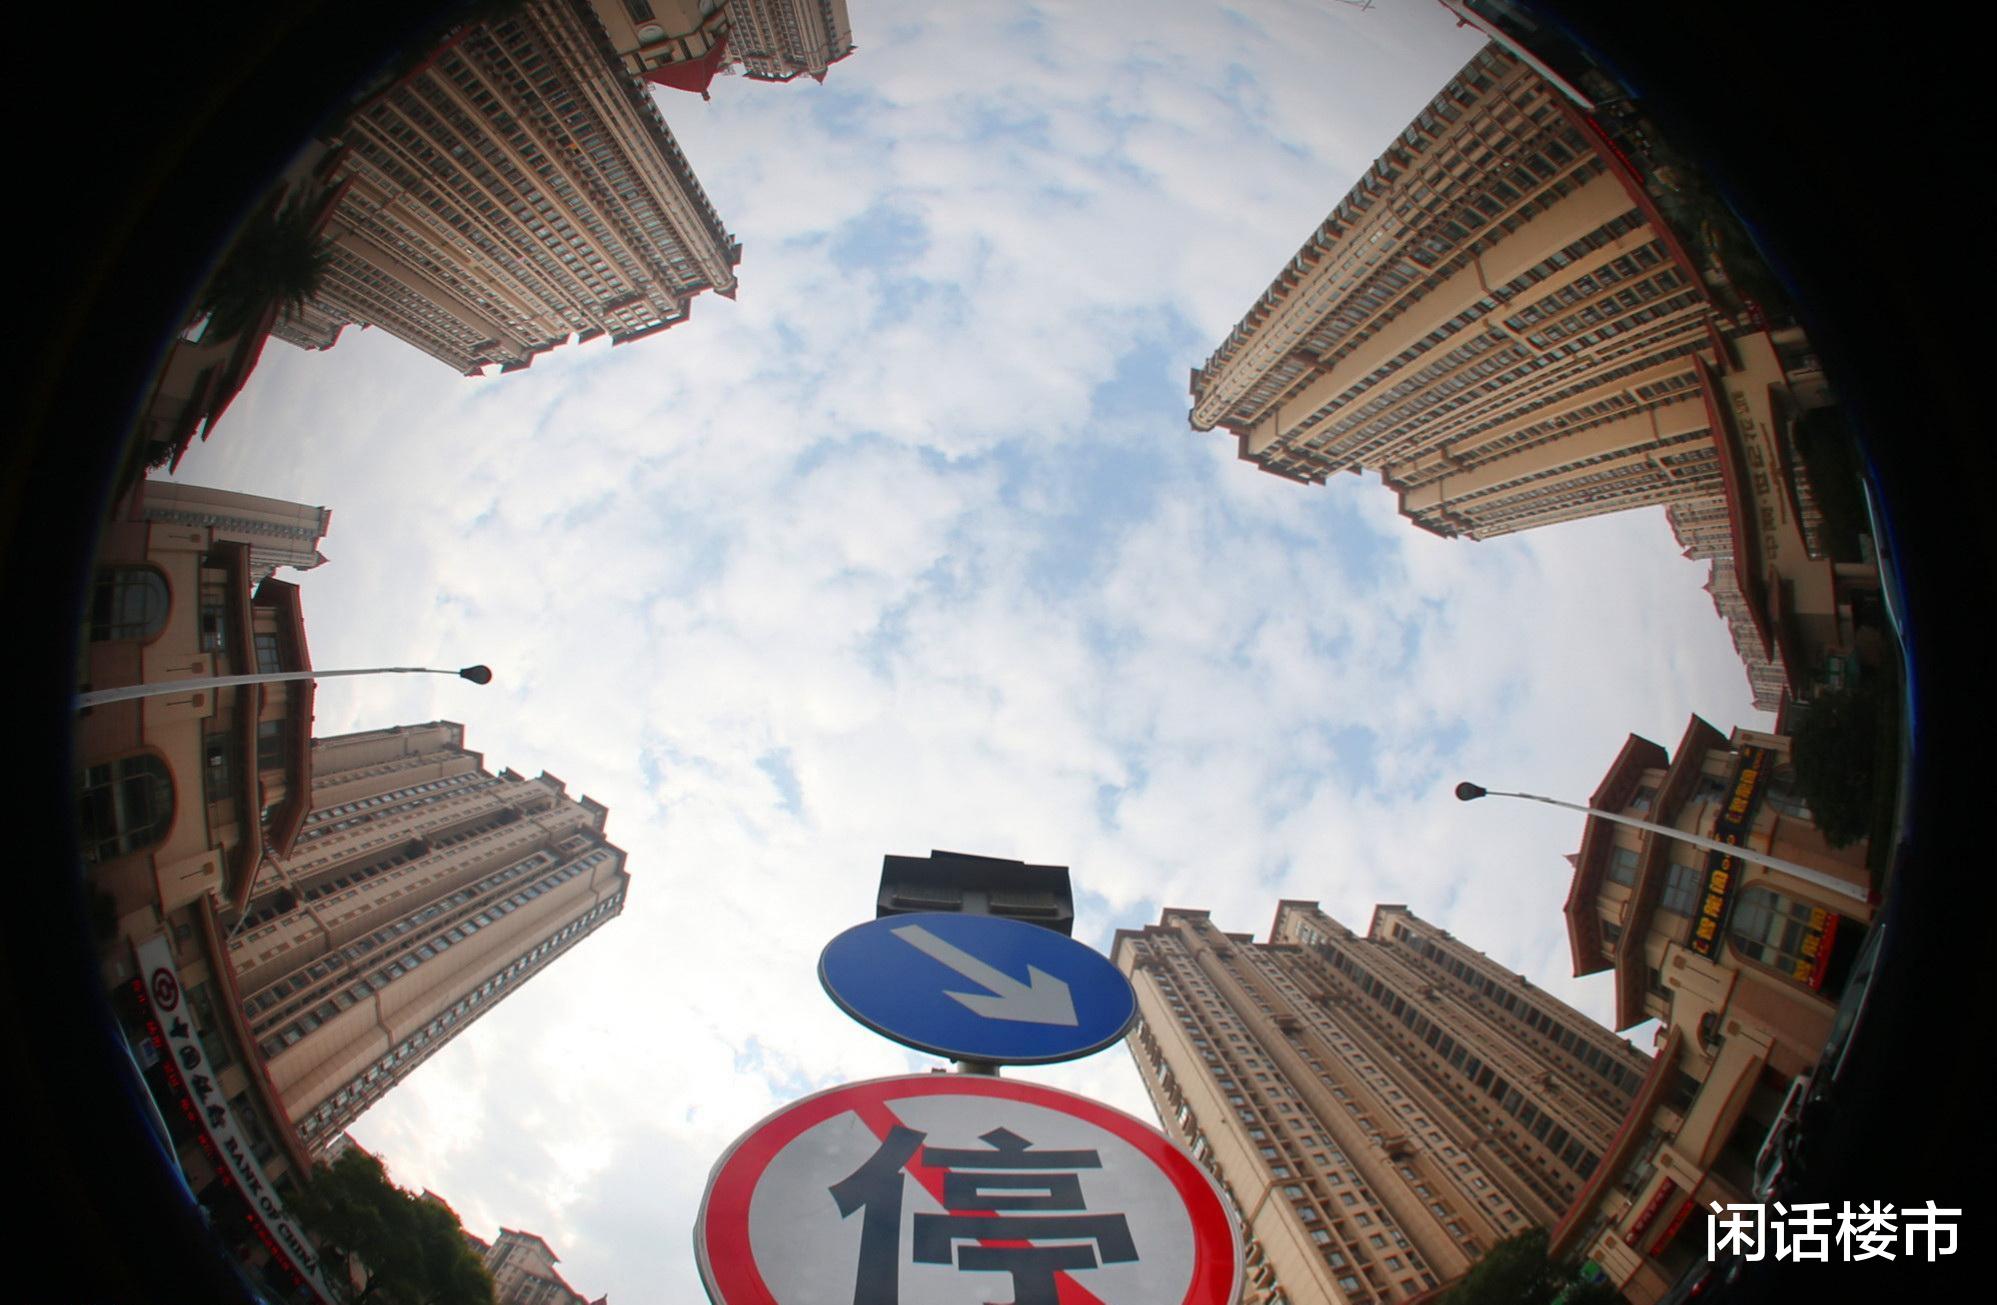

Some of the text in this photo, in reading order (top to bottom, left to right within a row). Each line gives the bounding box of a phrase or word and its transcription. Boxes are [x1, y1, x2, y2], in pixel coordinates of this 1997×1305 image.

[224, 1138, 264, 1200] BANK
[258, 1193, 283, 1220] OF
[277, 1221, 320, 1278] CHINA
[828, 1125, 1139, 1305] 停
